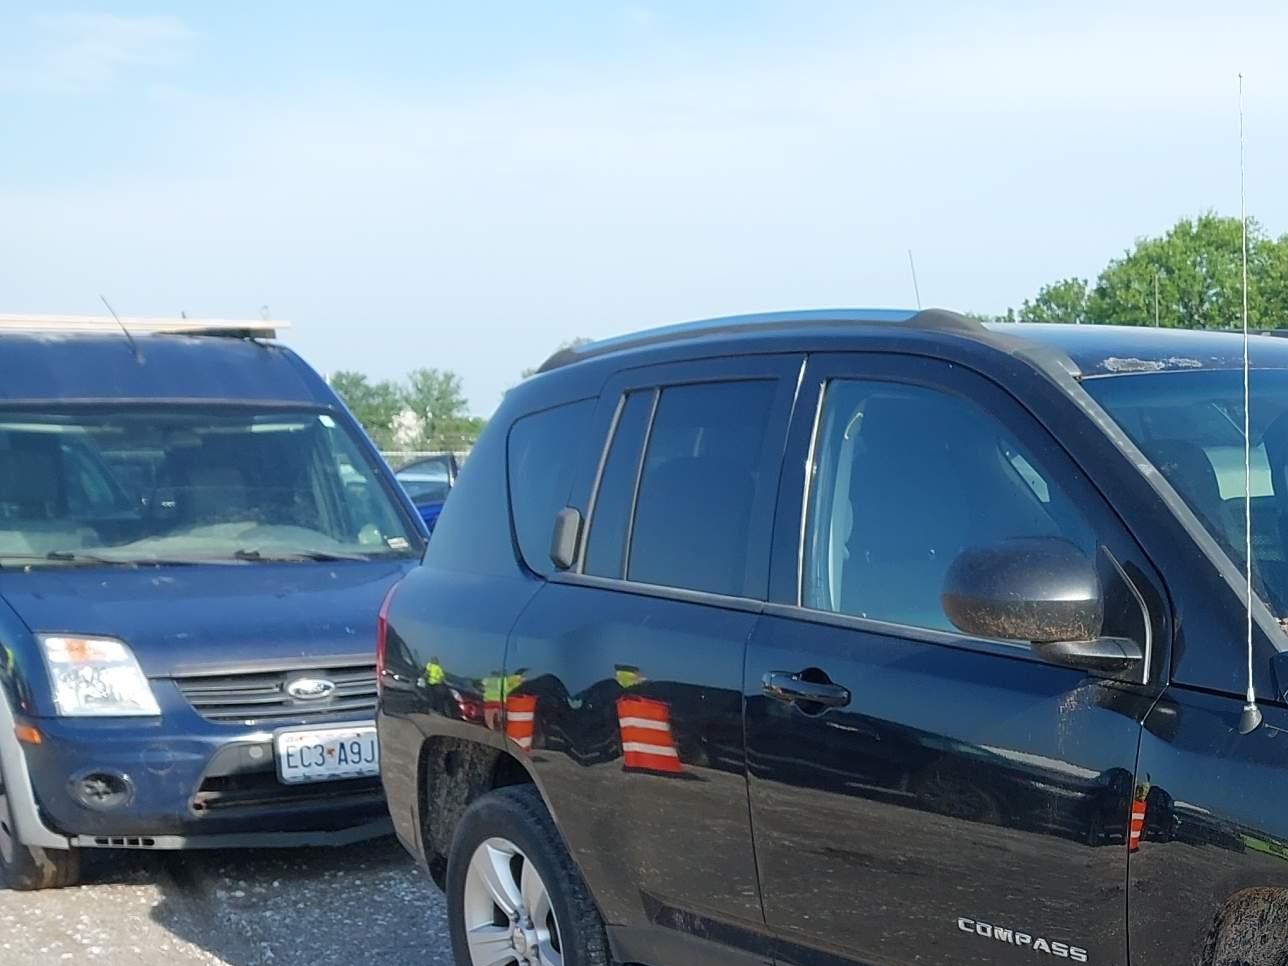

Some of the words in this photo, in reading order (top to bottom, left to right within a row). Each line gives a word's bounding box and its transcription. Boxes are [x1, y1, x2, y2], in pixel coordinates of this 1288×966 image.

[286, 744, 326, 769] EC3
[337, 740, 376, 766] A9J
[957, 917, 1088, 963] COMPASS
